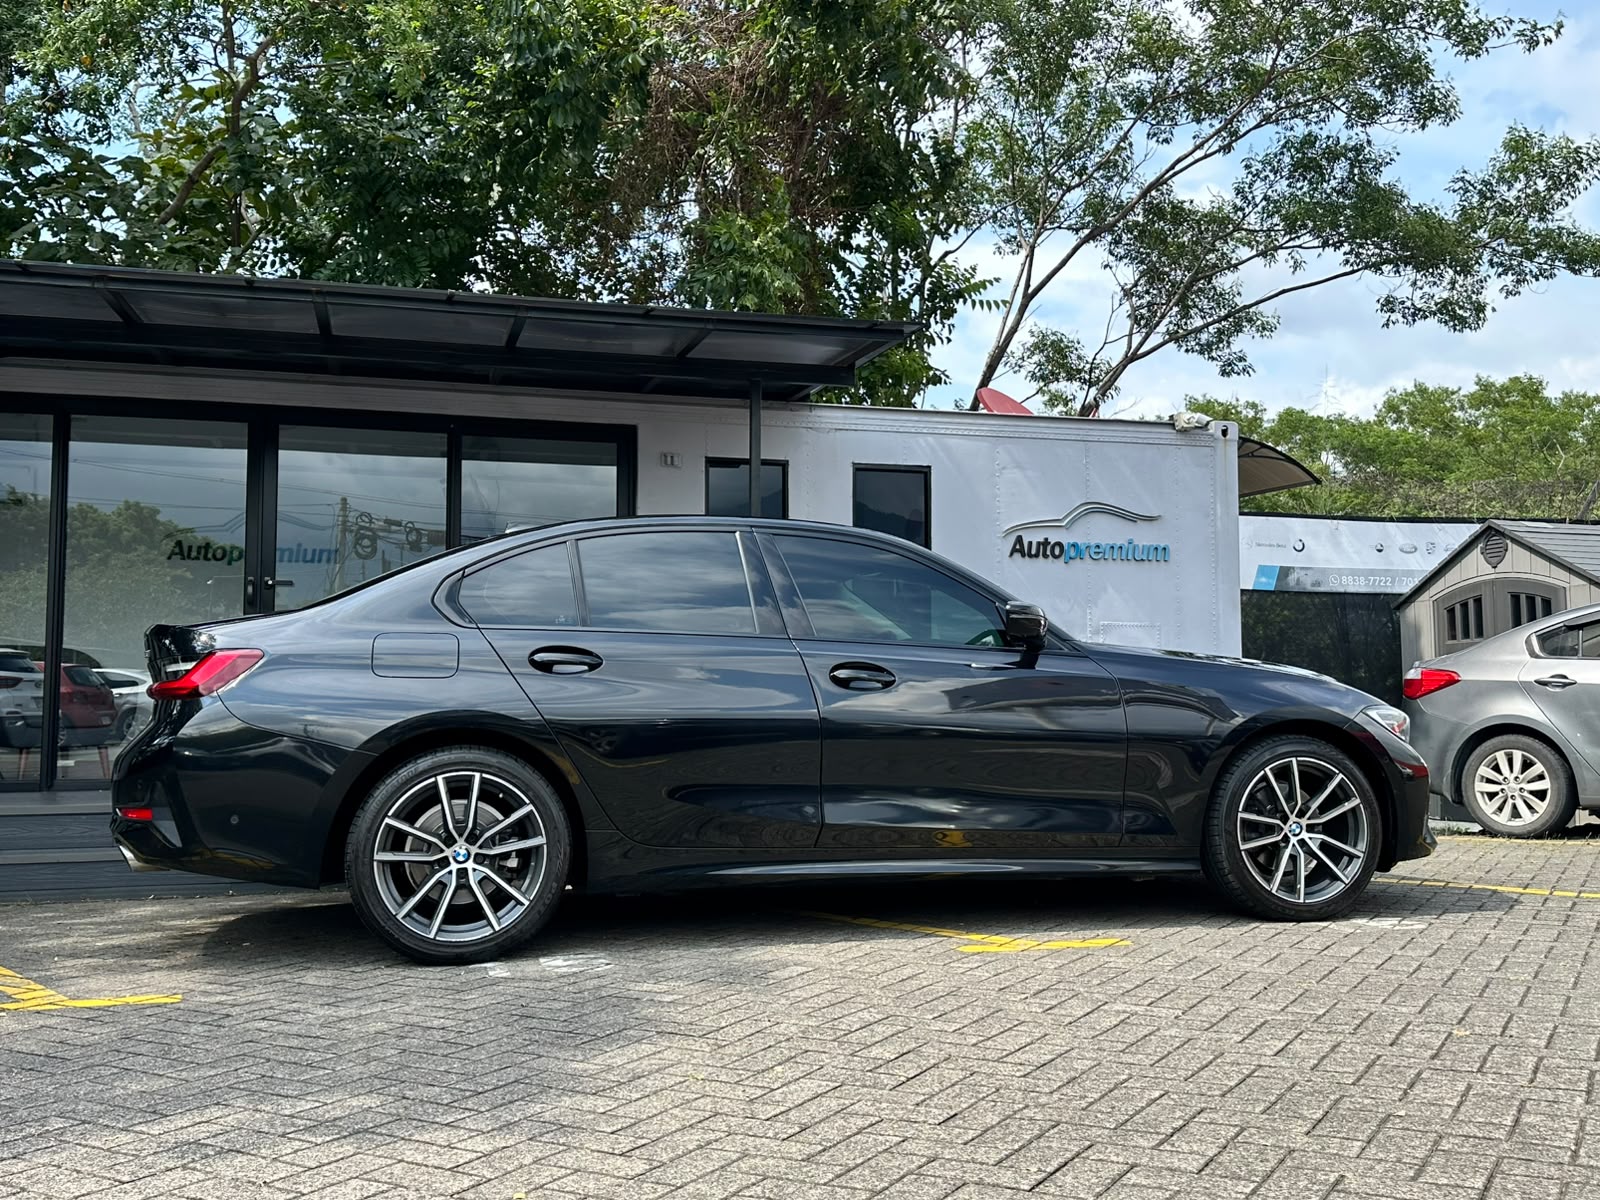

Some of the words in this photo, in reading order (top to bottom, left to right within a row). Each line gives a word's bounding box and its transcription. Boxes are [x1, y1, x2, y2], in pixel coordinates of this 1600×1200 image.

[167, 540, 338, 565] Autopmium
[1009, 535, 1170, 563] Autopremium
[1341, 576, 1392, 586] 8838-7722
